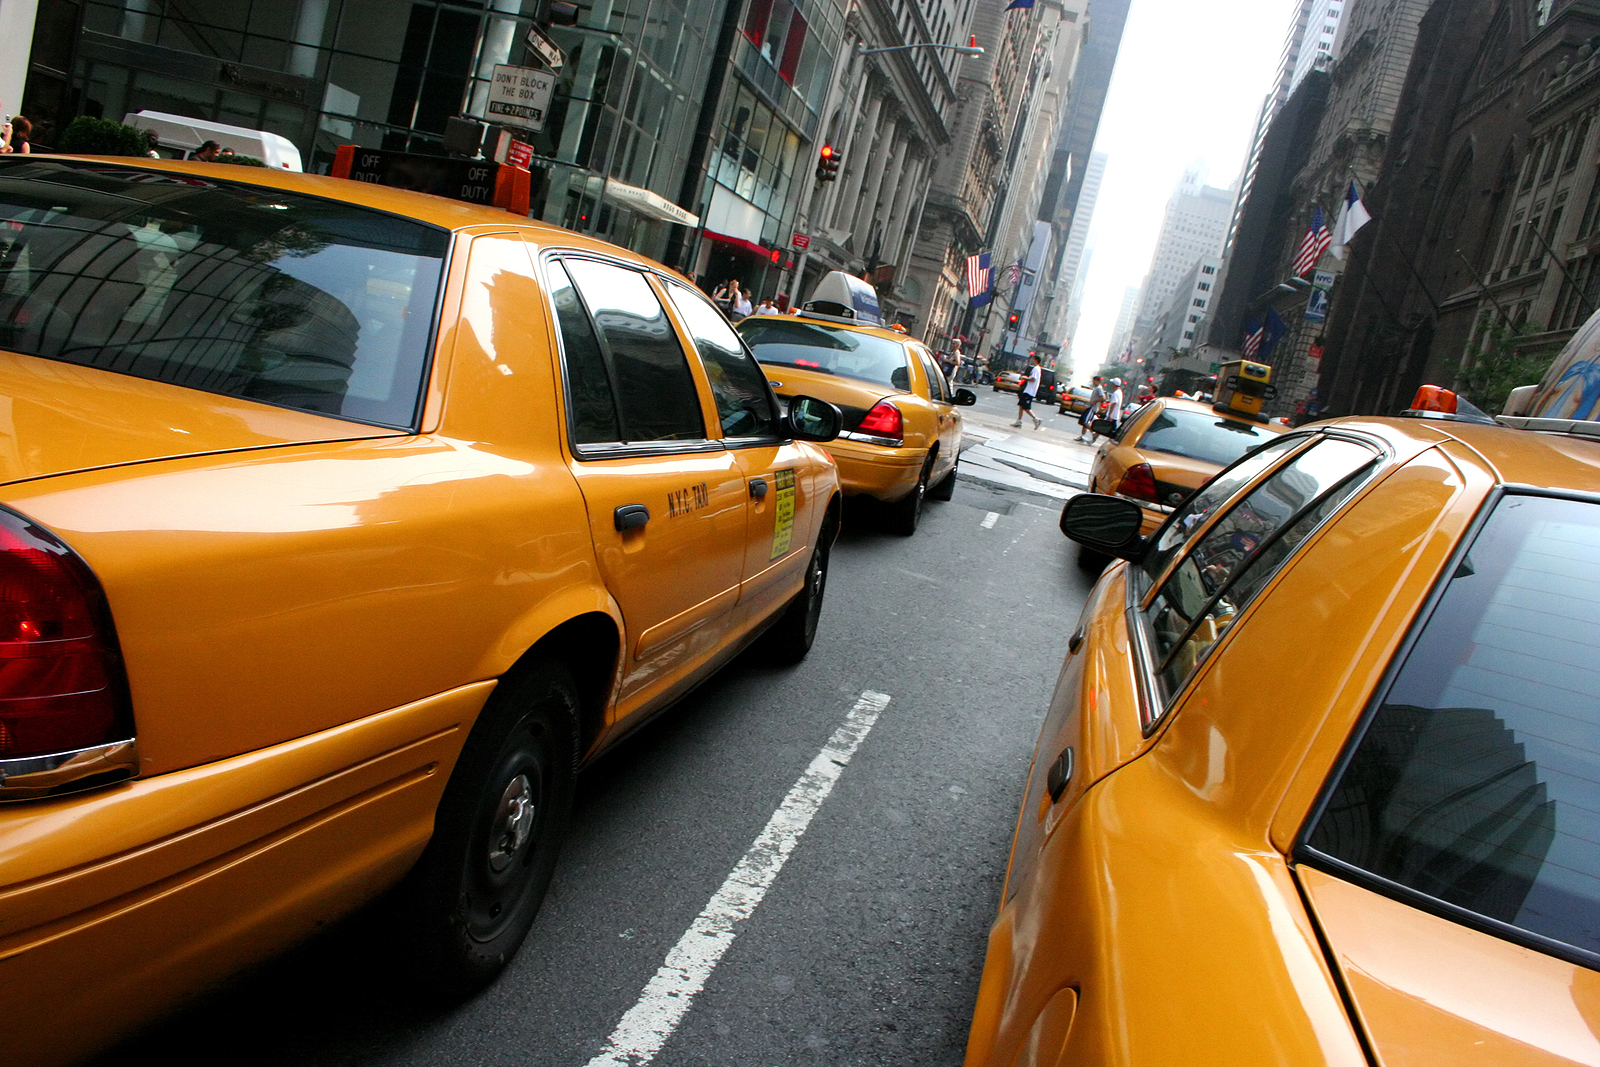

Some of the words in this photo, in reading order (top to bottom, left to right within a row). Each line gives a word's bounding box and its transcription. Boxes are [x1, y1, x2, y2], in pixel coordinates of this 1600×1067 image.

[531, 34, 545, 50] ONE
[548, 50, 561, 65] WAY
[496, 73, 518, 84] DON'T
[520, 77, 548, 92] BLOCK
[502, 86, 515, 97] THE
[518, 89, 536, 101] BOX
[361, 154, 381, 168] OFF
[355, 171, 382, 184] DUTY
[468, 167, 489, 182] OFF
[461, 185, 489, 200] DUTY
[1316, 274, 1333, 283] NYC
[692, 482, 708, 510] TAXI
